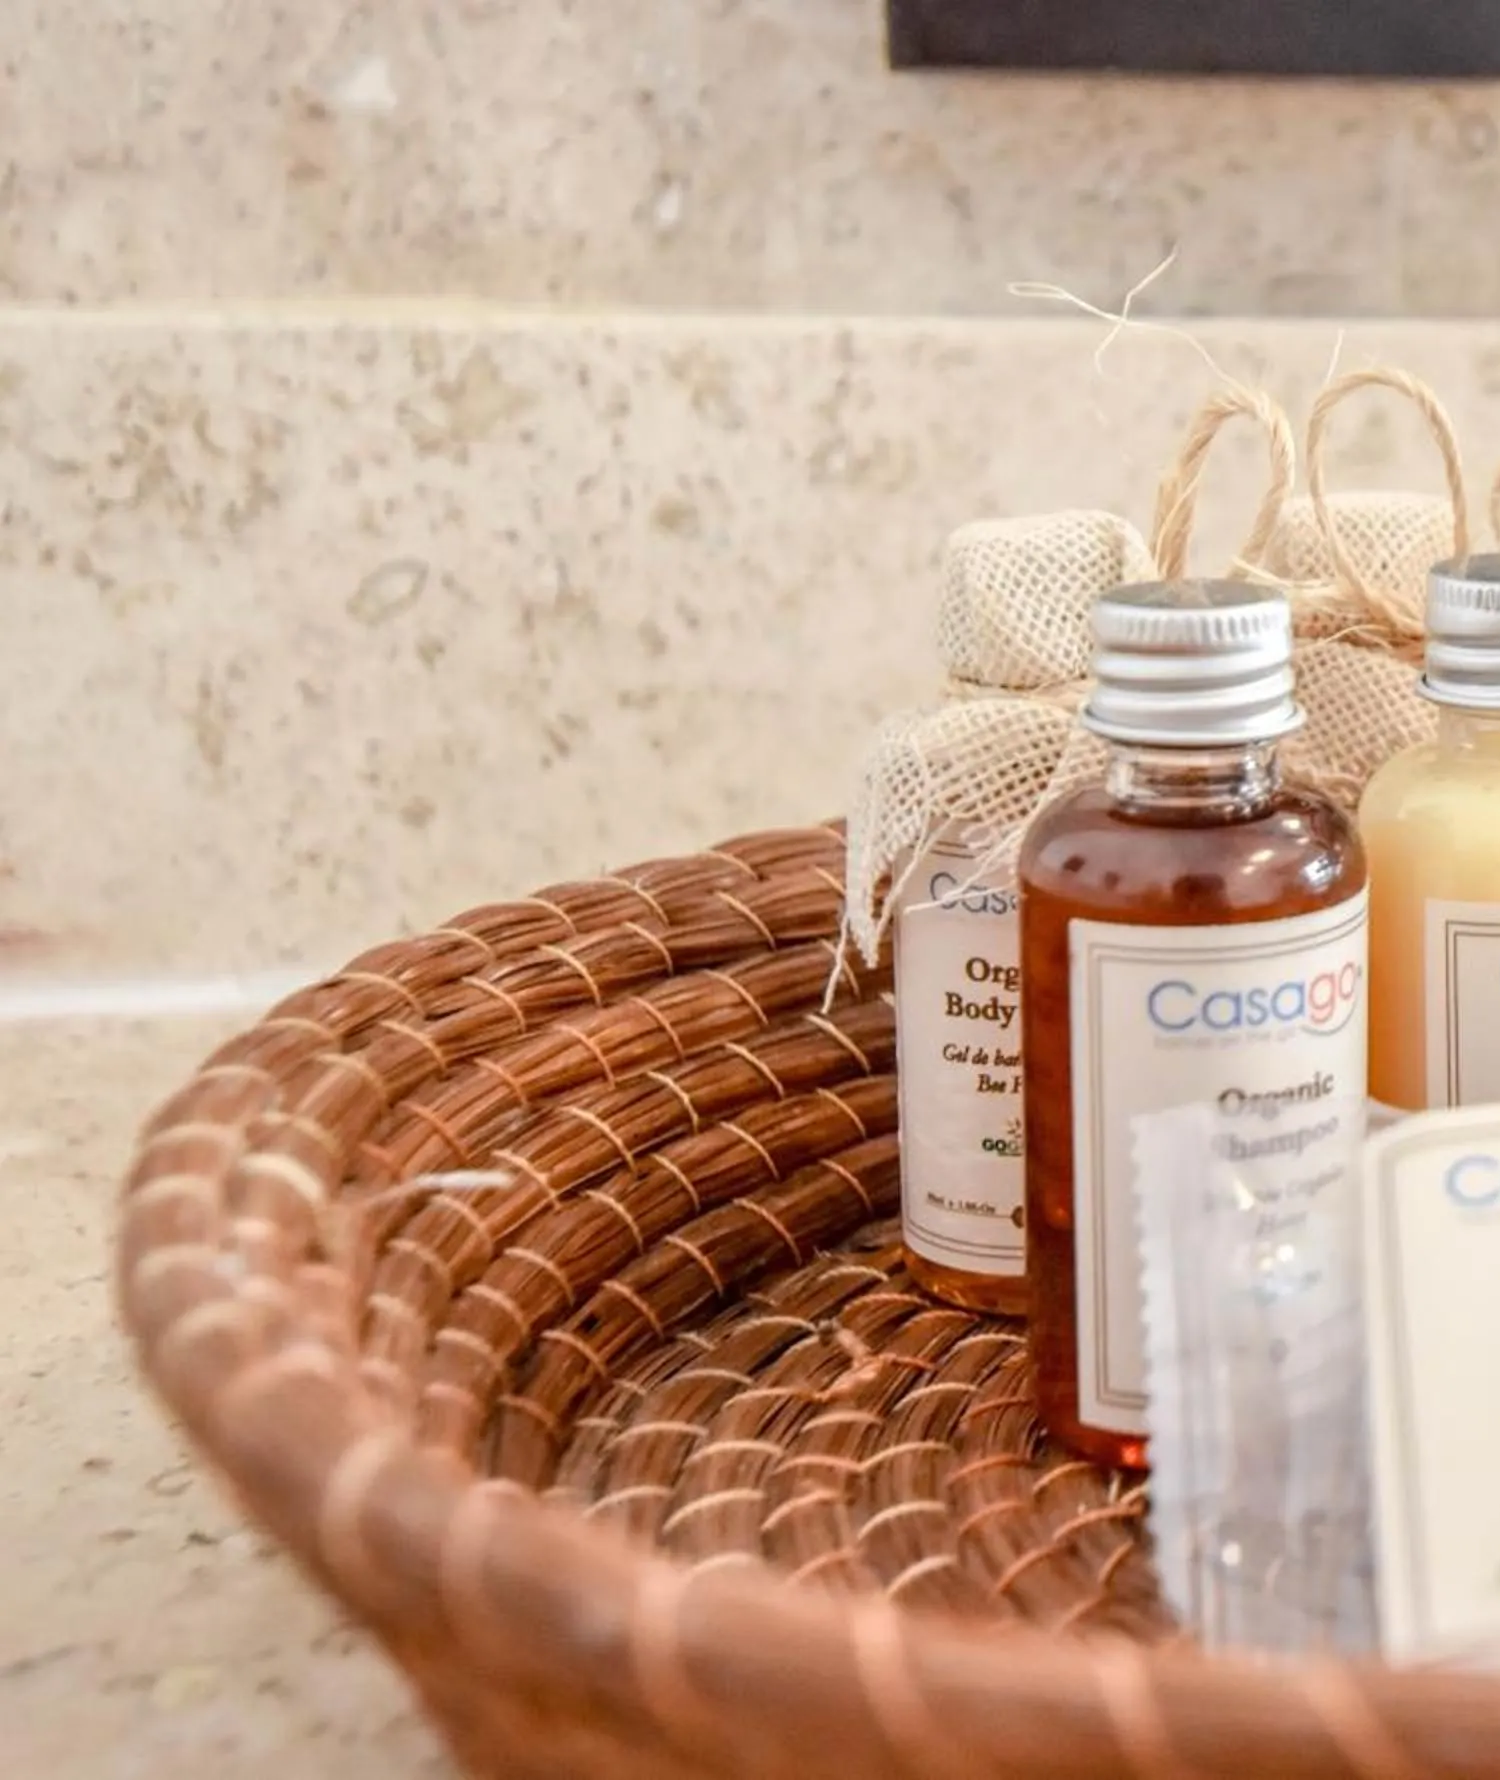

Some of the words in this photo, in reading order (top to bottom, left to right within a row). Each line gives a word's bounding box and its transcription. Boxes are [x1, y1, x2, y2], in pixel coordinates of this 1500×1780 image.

[945, 991, 1017, 1029] Body
[1147, 961, 1356, 1032] Casago
[1217, 1071, 1334, 1120] Organic
